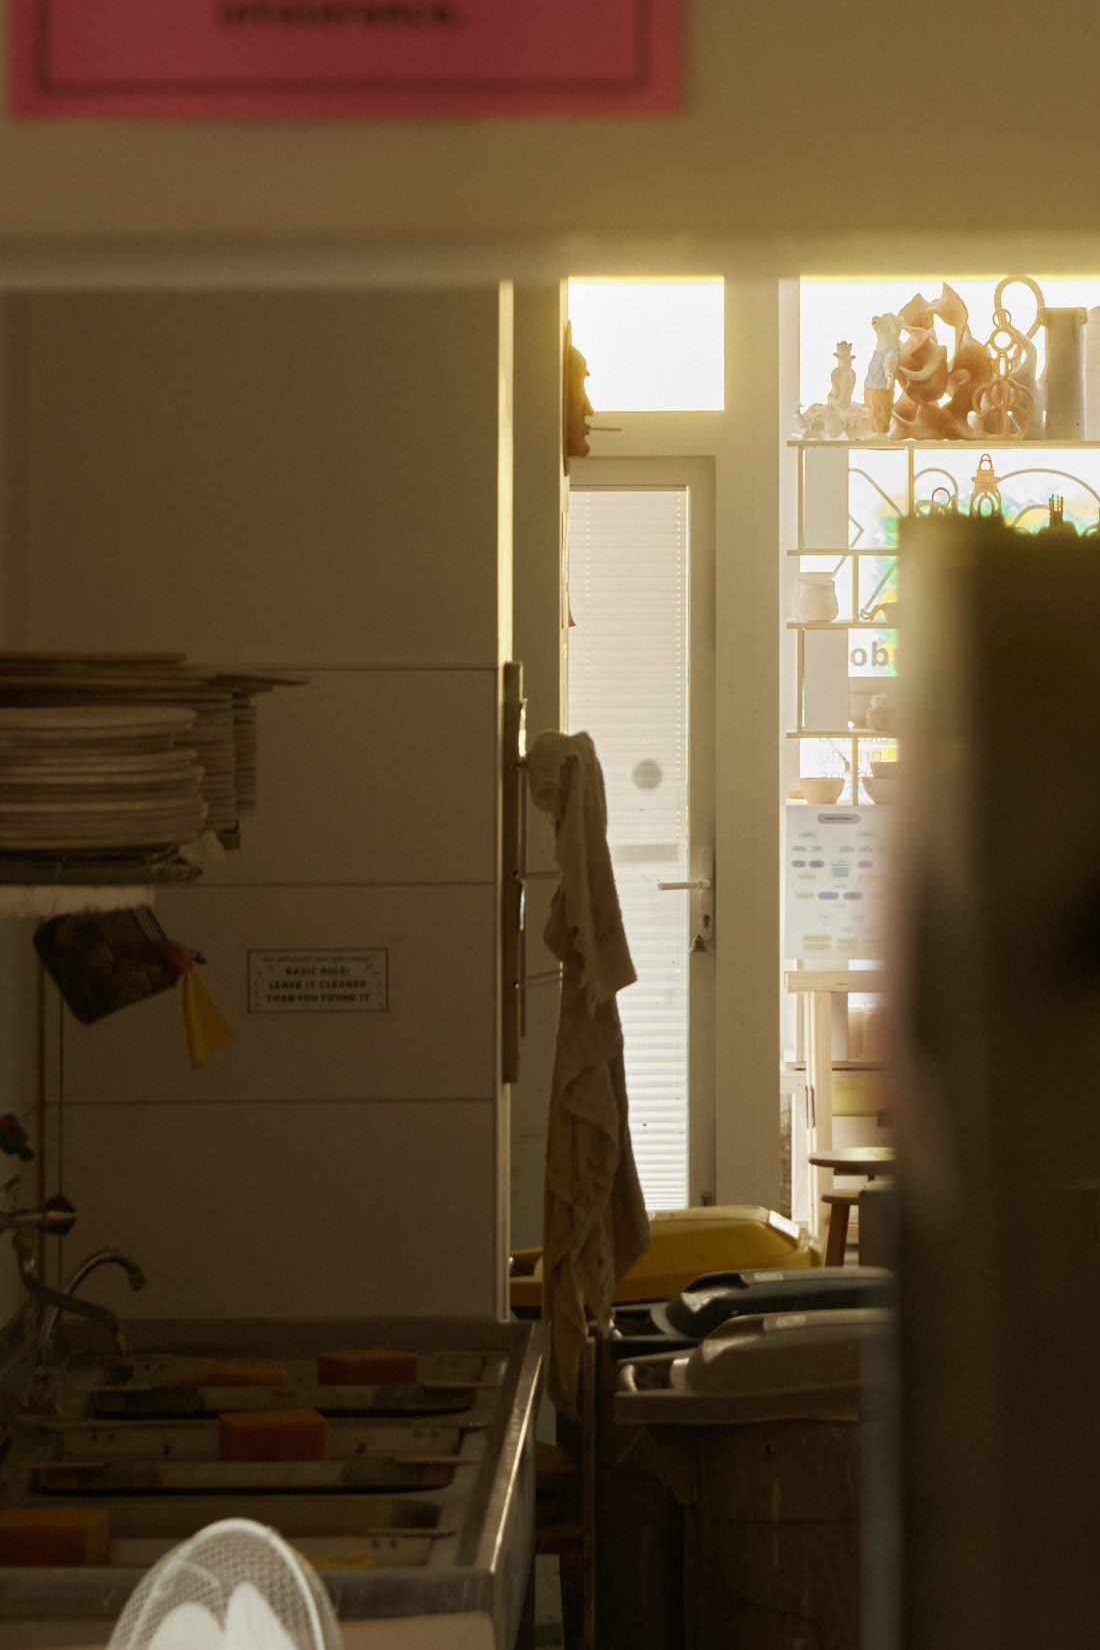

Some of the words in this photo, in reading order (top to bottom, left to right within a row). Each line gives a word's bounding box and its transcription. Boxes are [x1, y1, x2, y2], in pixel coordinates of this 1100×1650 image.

[286, 966, 317, 976] BASIC
[269, 980, 302, 989] LEAVE
[305, 980, 315, 989] IT
[319, 979, 367, 988] CLEANER
[266, 993, 295, 1003] THAN
[298, 993, 318, 1002] YOU
[321, 993, 357, 1002] FOUND
[360, 992, 370, 1001] IT
